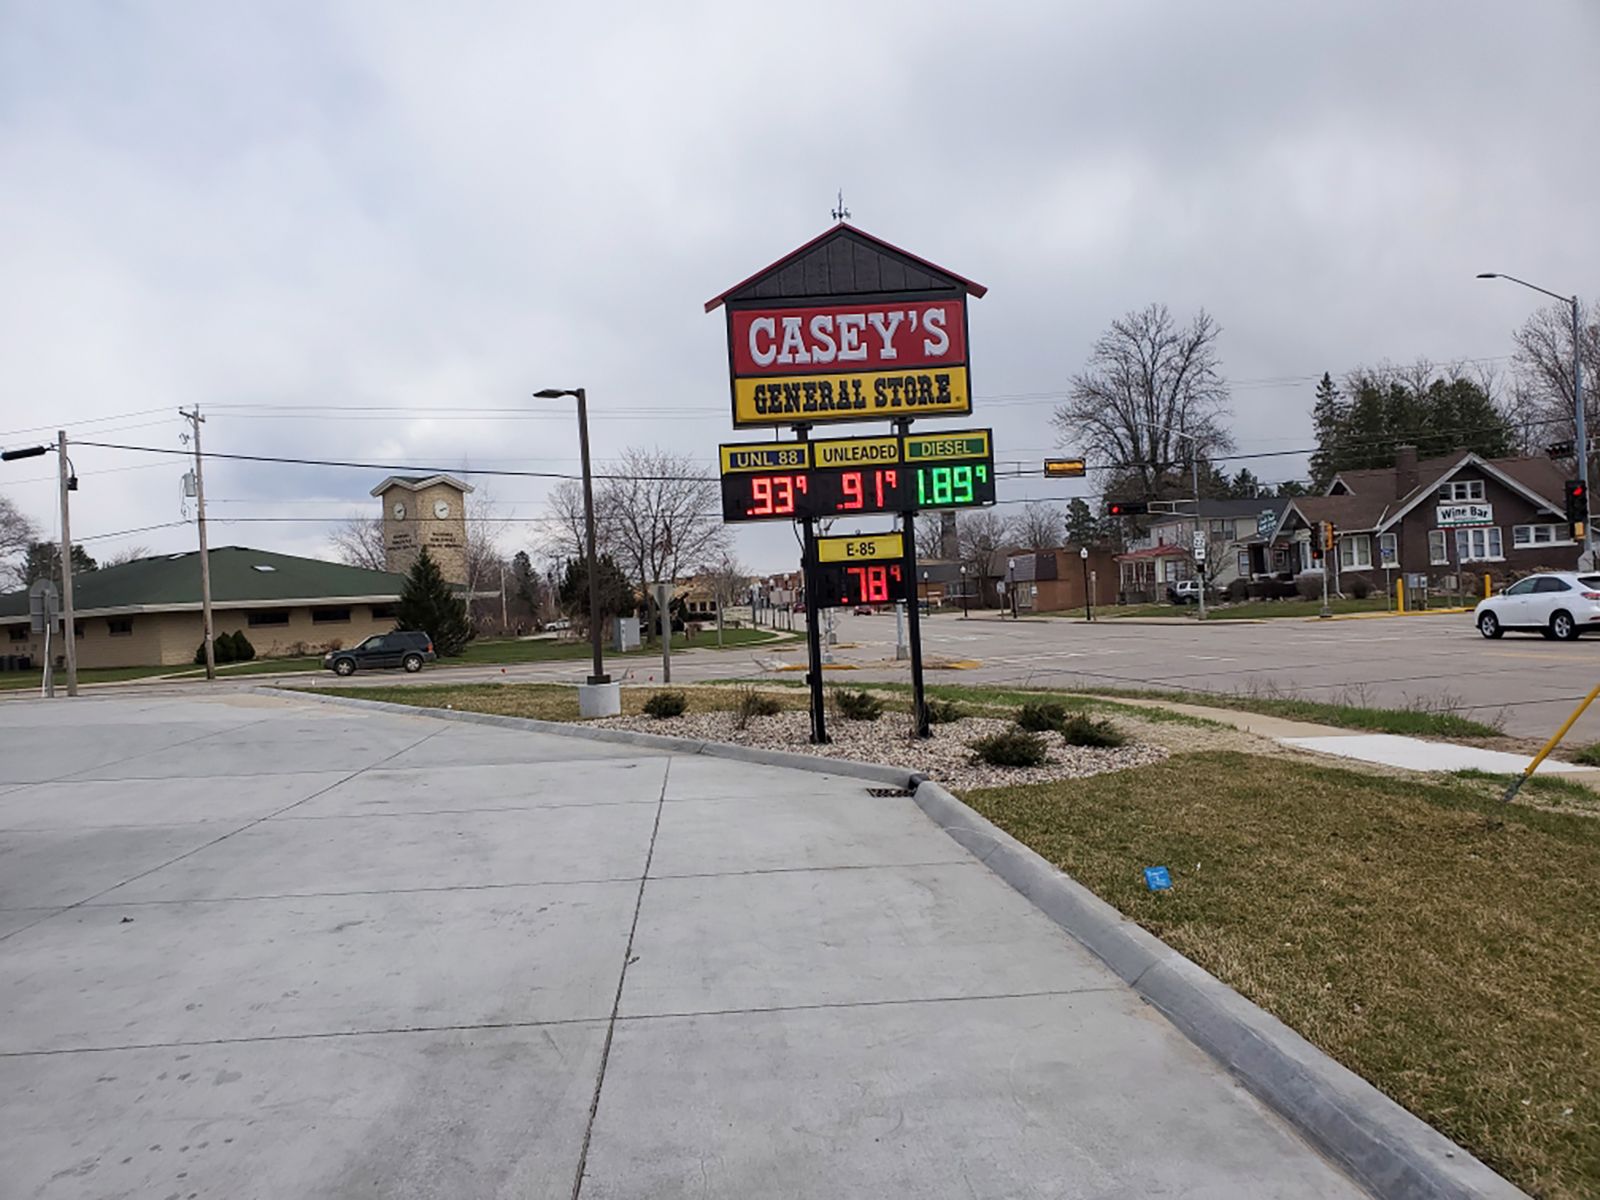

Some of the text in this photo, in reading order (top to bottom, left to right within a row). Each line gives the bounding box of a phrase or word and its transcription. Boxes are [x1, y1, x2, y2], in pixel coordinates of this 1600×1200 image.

[749, 308, 949, 367] CASEY'S
[754, 375, 951, 414] GENERAL STORE
[823, 444, 898, 462] UNLEADED
[922, 440, 971, 456] DIESEL
[737, 450, 798, 467] UNL 88
[1441, 506, 1488, 520] Wine Bar
[846, 542, 875, 557] E-85
